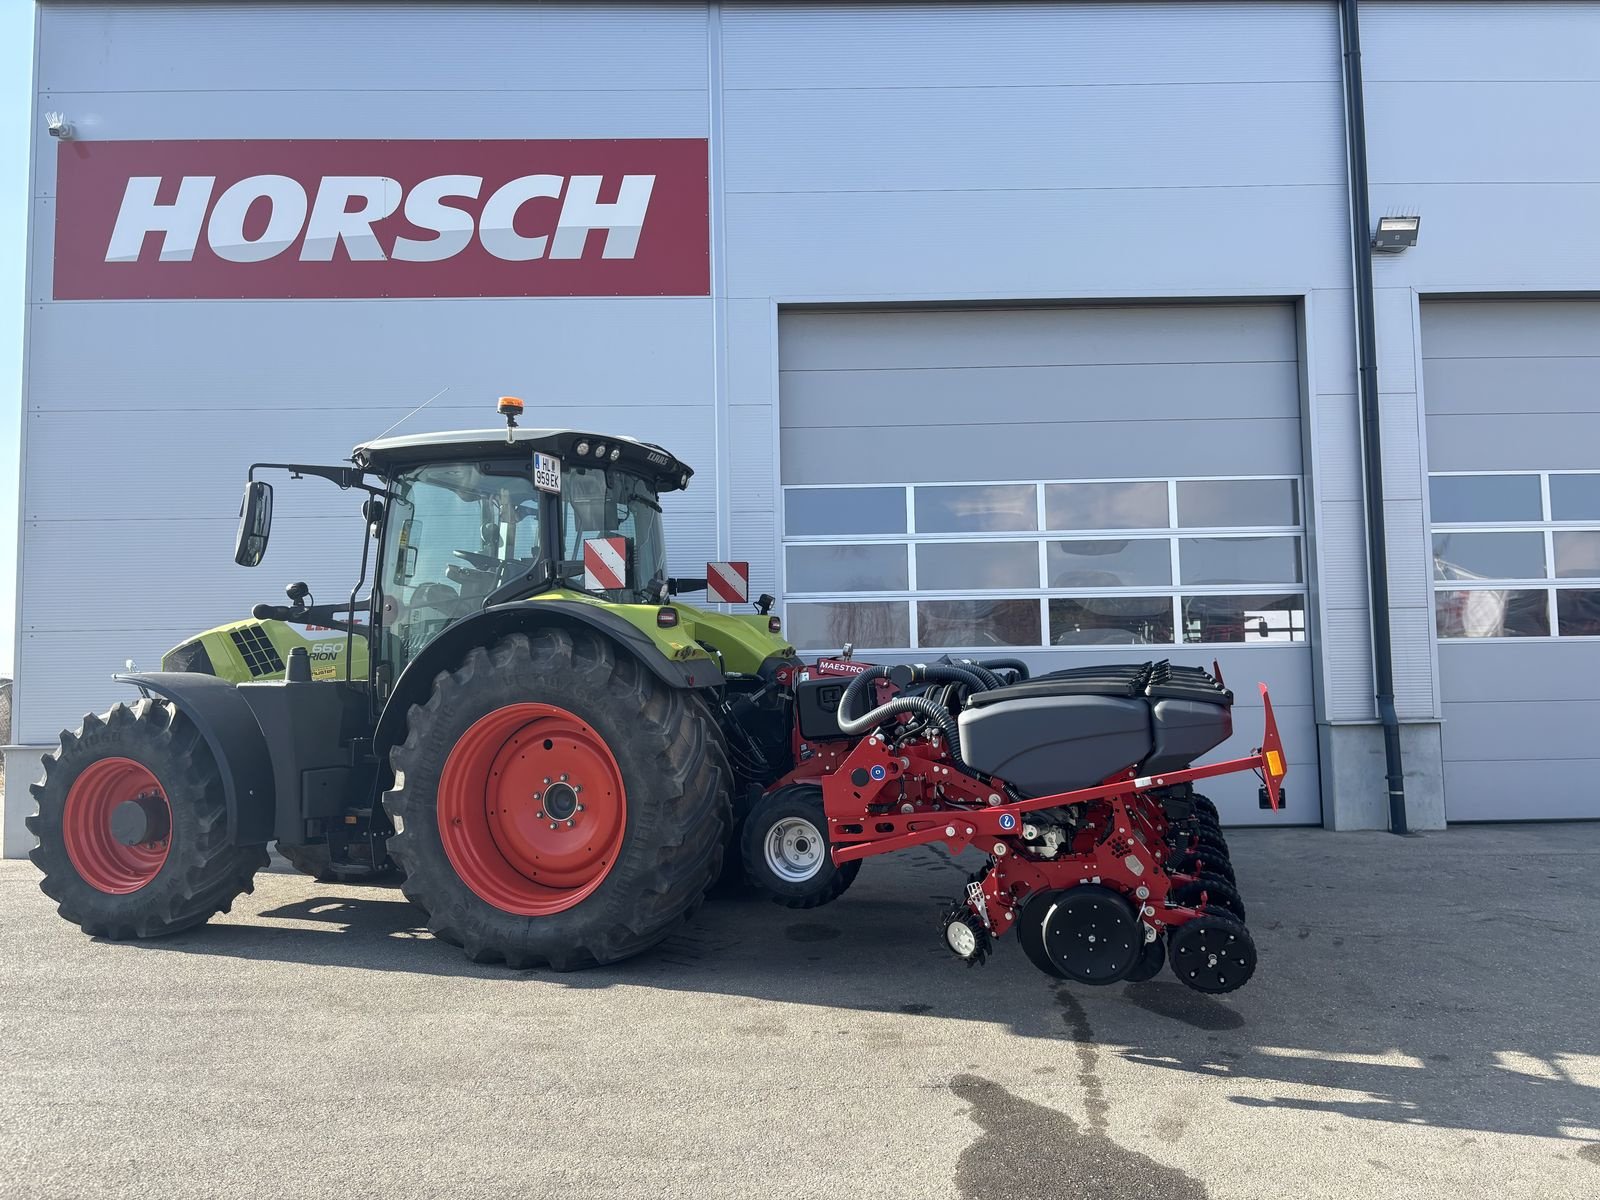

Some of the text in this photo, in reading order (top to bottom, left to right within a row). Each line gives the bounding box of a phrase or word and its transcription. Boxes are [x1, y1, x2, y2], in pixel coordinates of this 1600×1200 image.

[104, 173, 657, 264] HORSCH
[536, 470, 559, 489] 959 EK
[312, 643, 344, 653] 660
[309, 652, 337, 661] RION
[819, 661, 864, 674] MAESTRO
